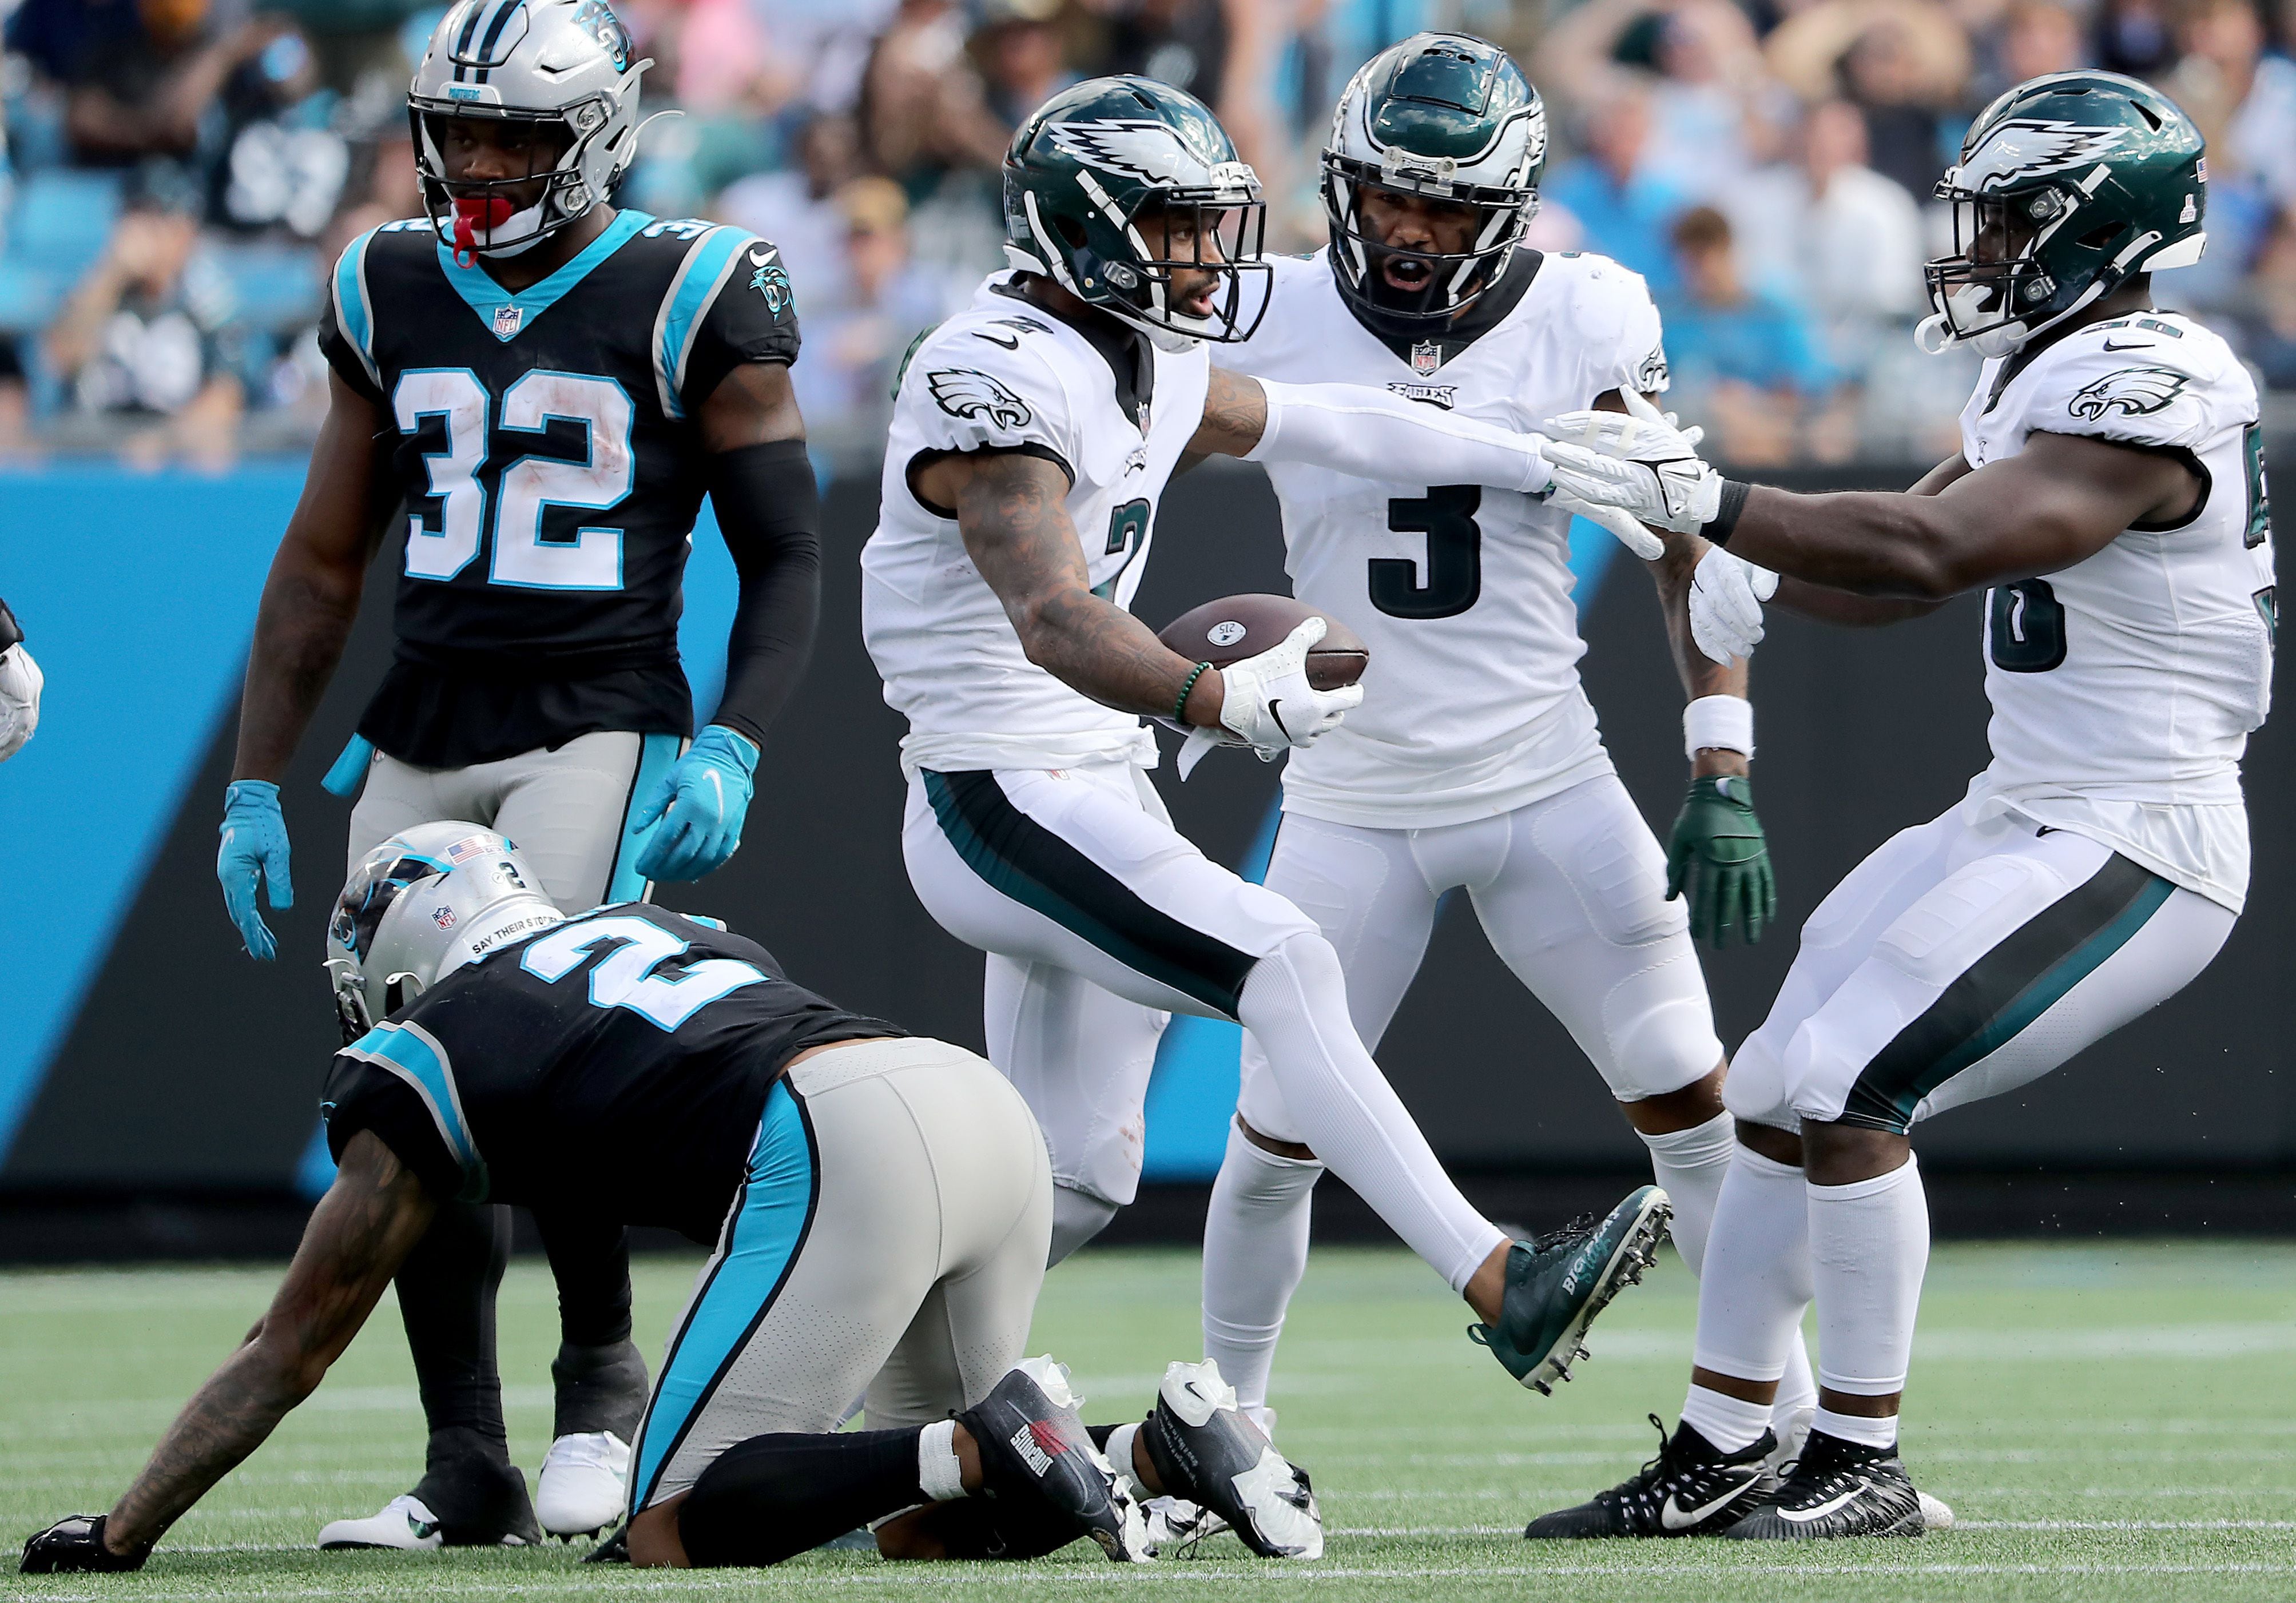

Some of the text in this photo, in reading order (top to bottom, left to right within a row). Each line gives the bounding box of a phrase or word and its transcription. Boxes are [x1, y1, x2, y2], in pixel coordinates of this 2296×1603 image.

[497, 319, 514, 332] NFL
[1416, 355, 1435, 368] NFL
[1387, 383, 1459, 411] EAGLES
[392, 367, 635, 590] 32
[1368, 484, 1481, 614] 3
[1219, 623, 1236, 634] 215
[498, 861, 527, 889] 2
[438, 914, 456, 928] NFL
[472, 936, 493, 954] SAY
[494, 920, 526, 940] THEIR
[519, 916, 770, 1033] 2
[1562, 1256, 1587, 1296] BIG
[1010, 1423, 1054, 1477] DREAMS
